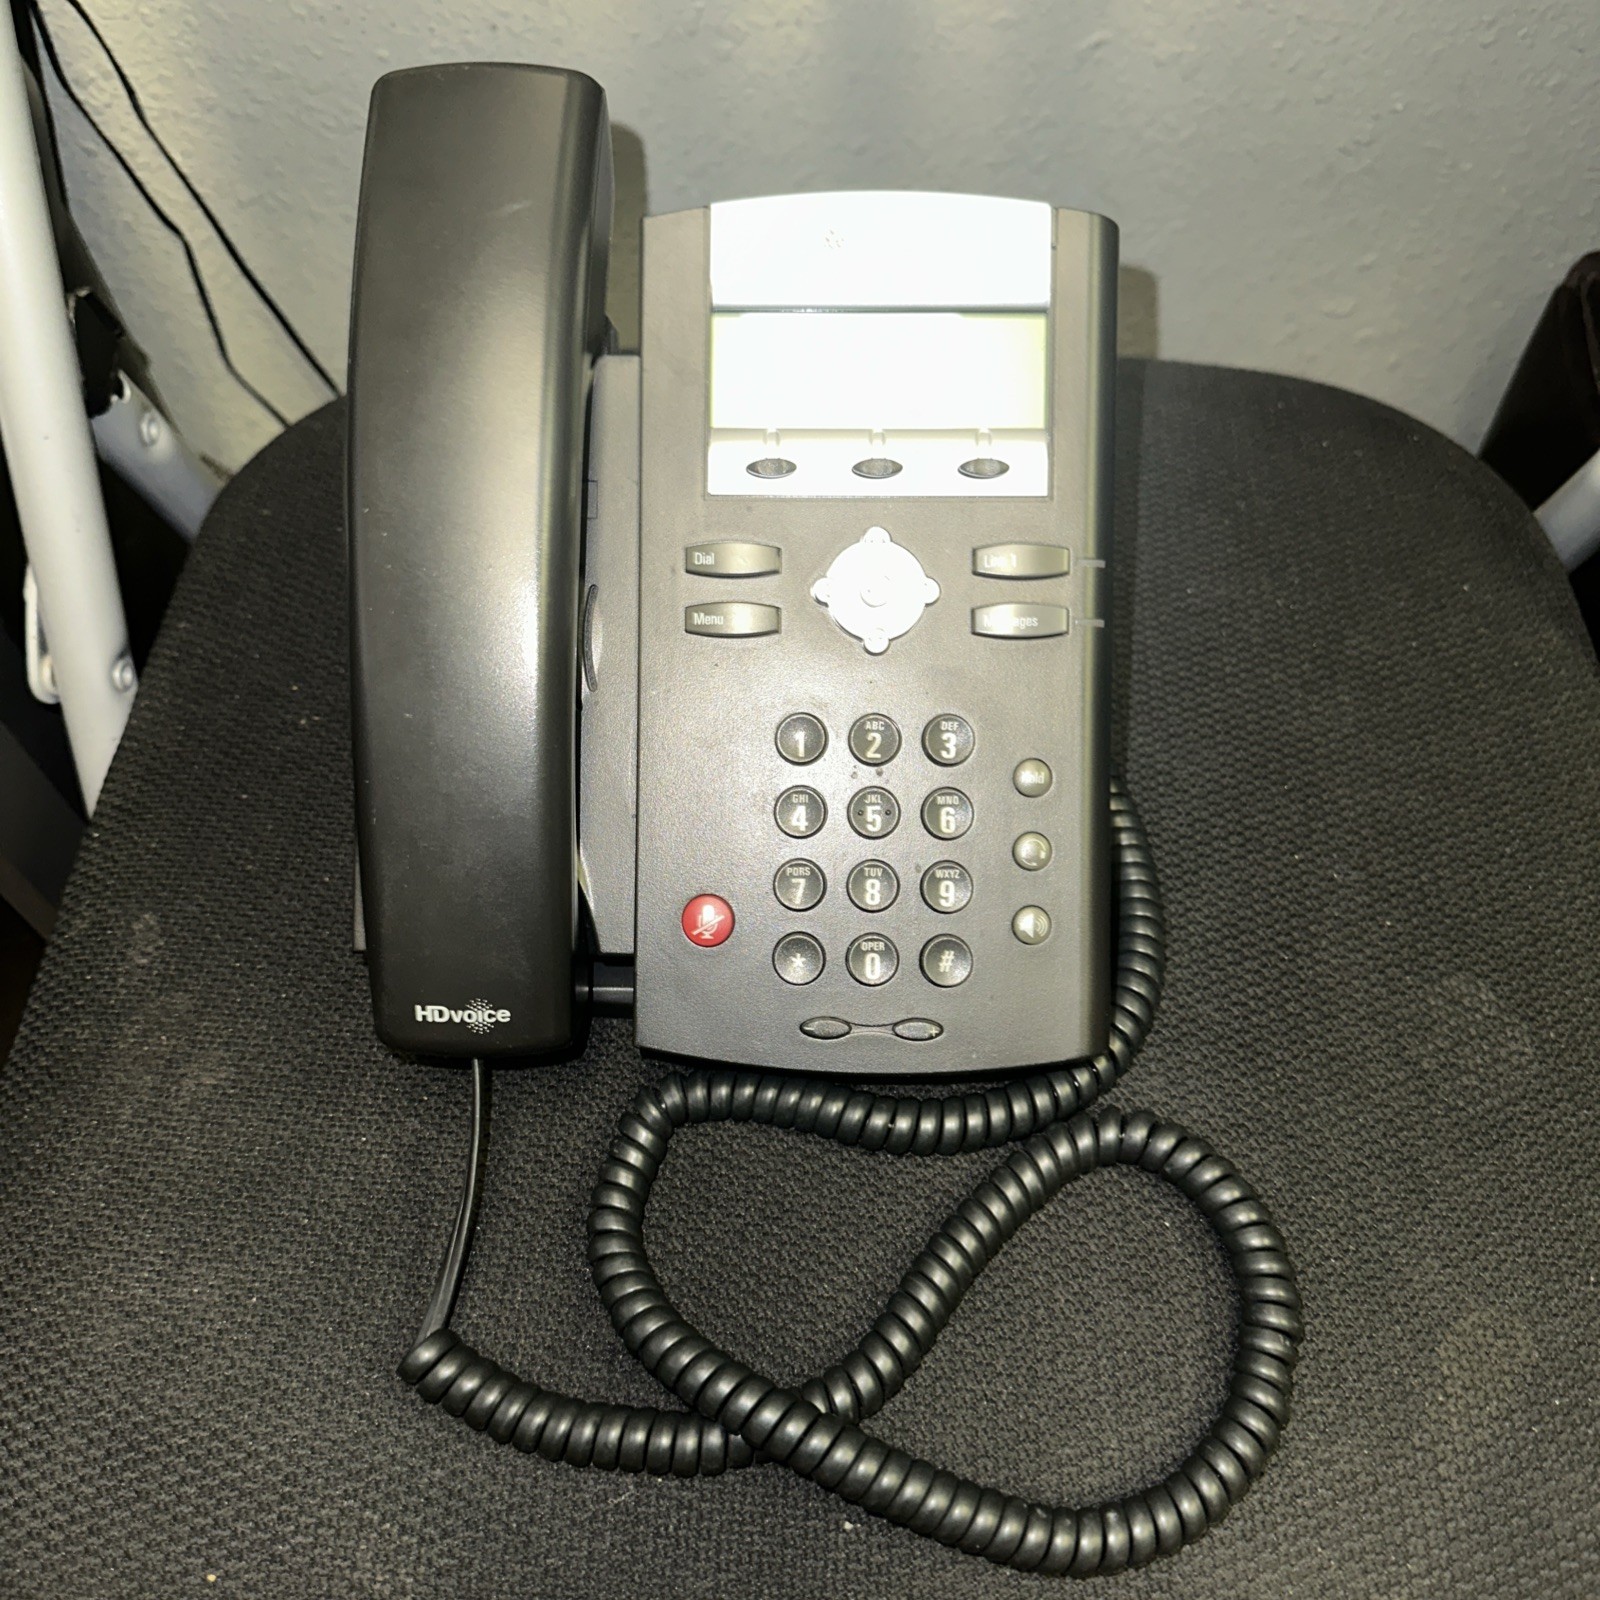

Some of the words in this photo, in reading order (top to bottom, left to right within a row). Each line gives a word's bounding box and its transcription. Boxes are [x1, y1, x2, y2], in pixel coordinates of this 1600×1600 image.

[694, 551, 715, 565] Dial
[693, 612, 724, 625] Menu
[865, 721, 885, 730] ABC
[941, 721, 959, 730] DEF
[795, 731, 806, 758] 1
[866, 733, 882, 758] 2
[941, 733, 957, 759] 3
[792, 794, 809, 804] GHI
[864, 794, 882, 804] JKL
[937, 795, 959, 805] MNO
[792, 805, 808, 832] 4
[866, 805, 882, 832] 5
[940, 806, 956, 834] 6
[786, 867, 811, 877] PQRS
[864, 867, 883, 877] TUV
[935, 869, 960, 879] WXYZ
[791, 878, 806, 904] 7
[865, 879, 881, 906] 8
[939, 880, 955, 907] 9
[861, 941, 885, 951] OPER
[865, 953, 881, 980] 0
